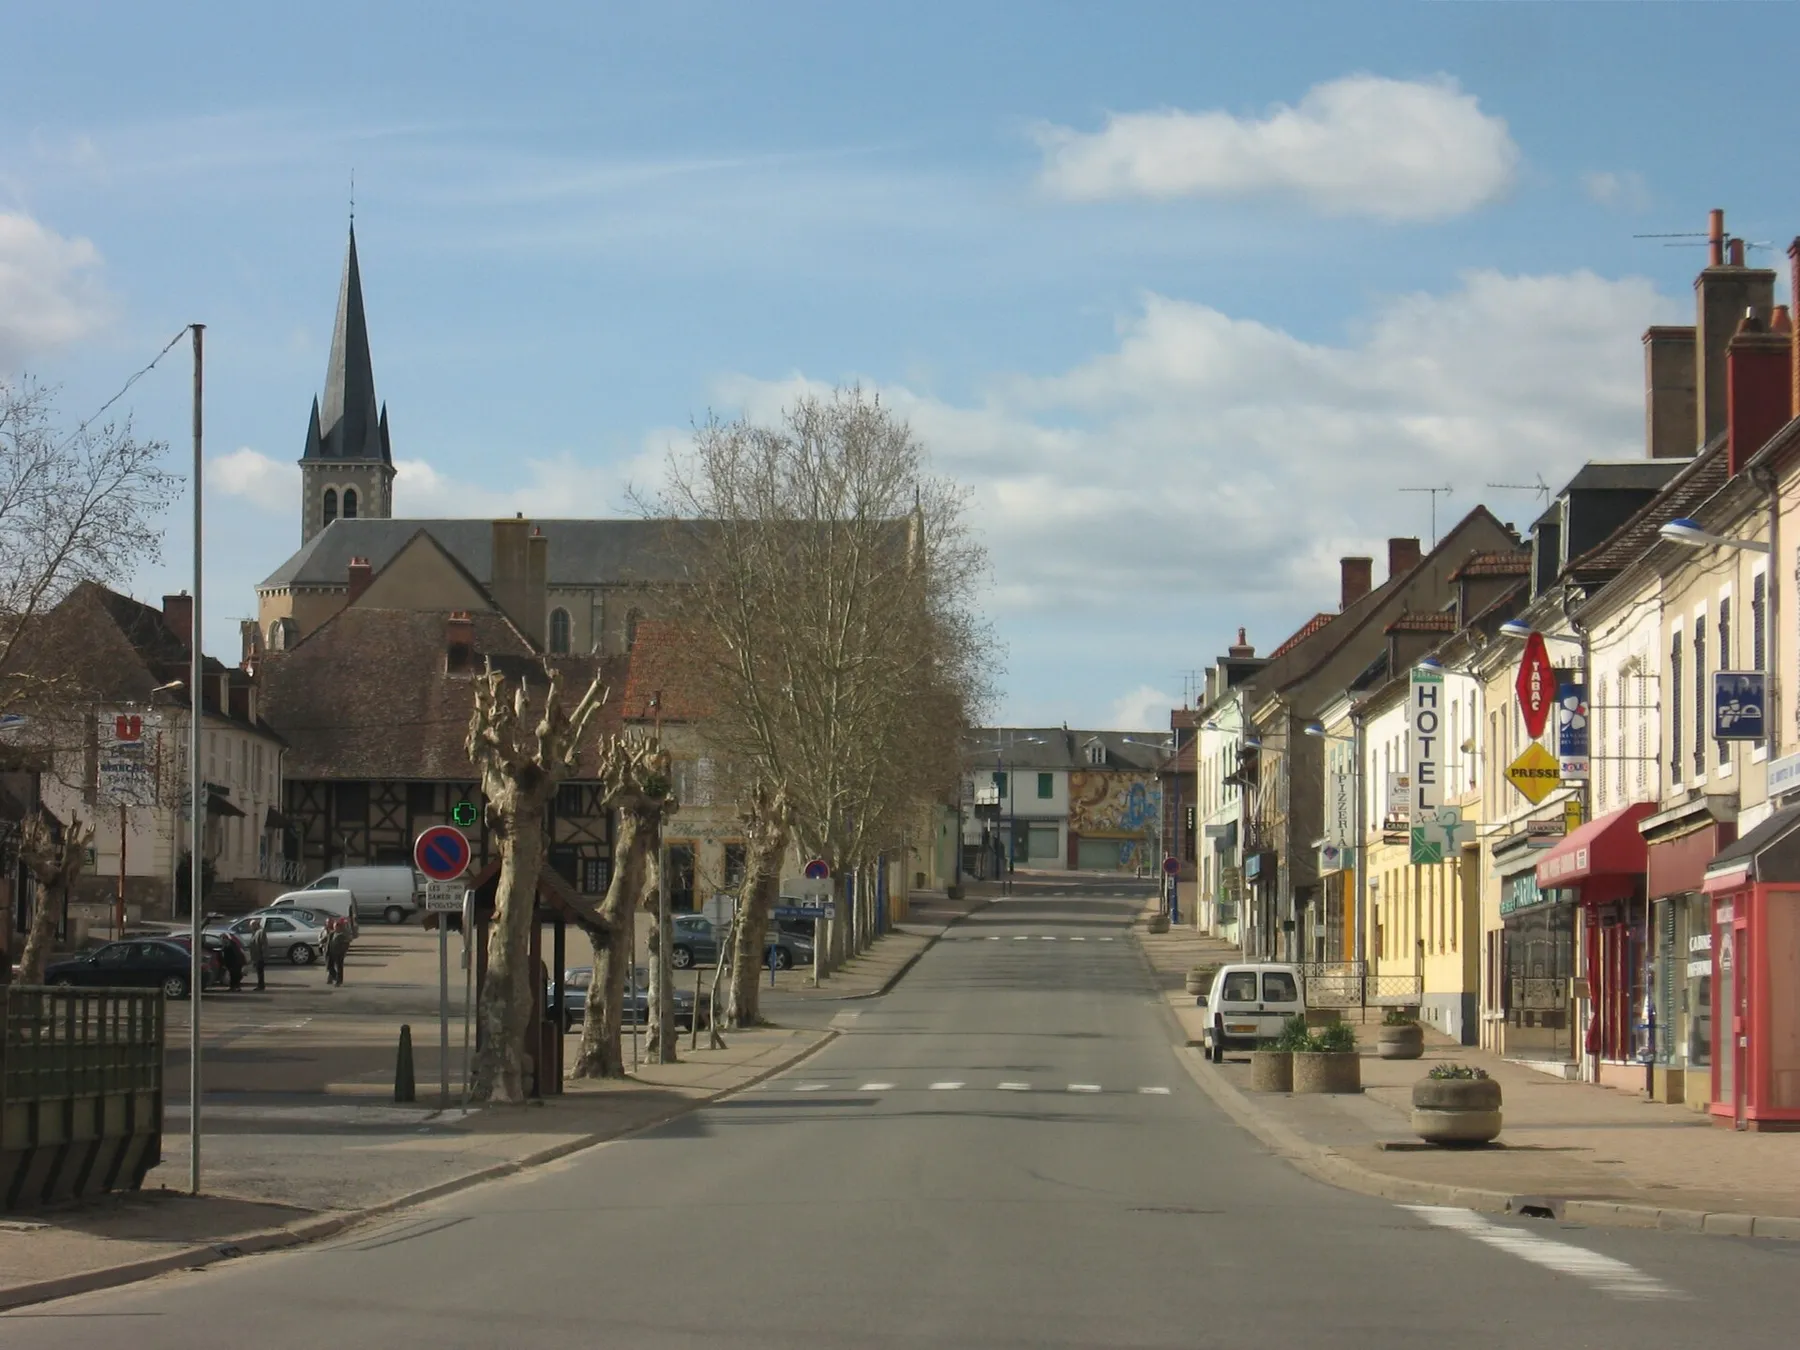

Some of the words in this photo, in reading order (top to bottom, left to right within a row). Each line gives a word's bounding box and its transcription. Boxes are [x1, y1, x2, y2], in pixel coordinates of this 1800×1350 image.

[1531, 662, 1541, 711] TABAC
[1417, 685, 1438, 810] HOTEL
[1511, 767, 1560, 779] PRESSE
[1337, 775, 1348, 847] PIZZERIA
[1386, 821, 1409, 831] CANA
